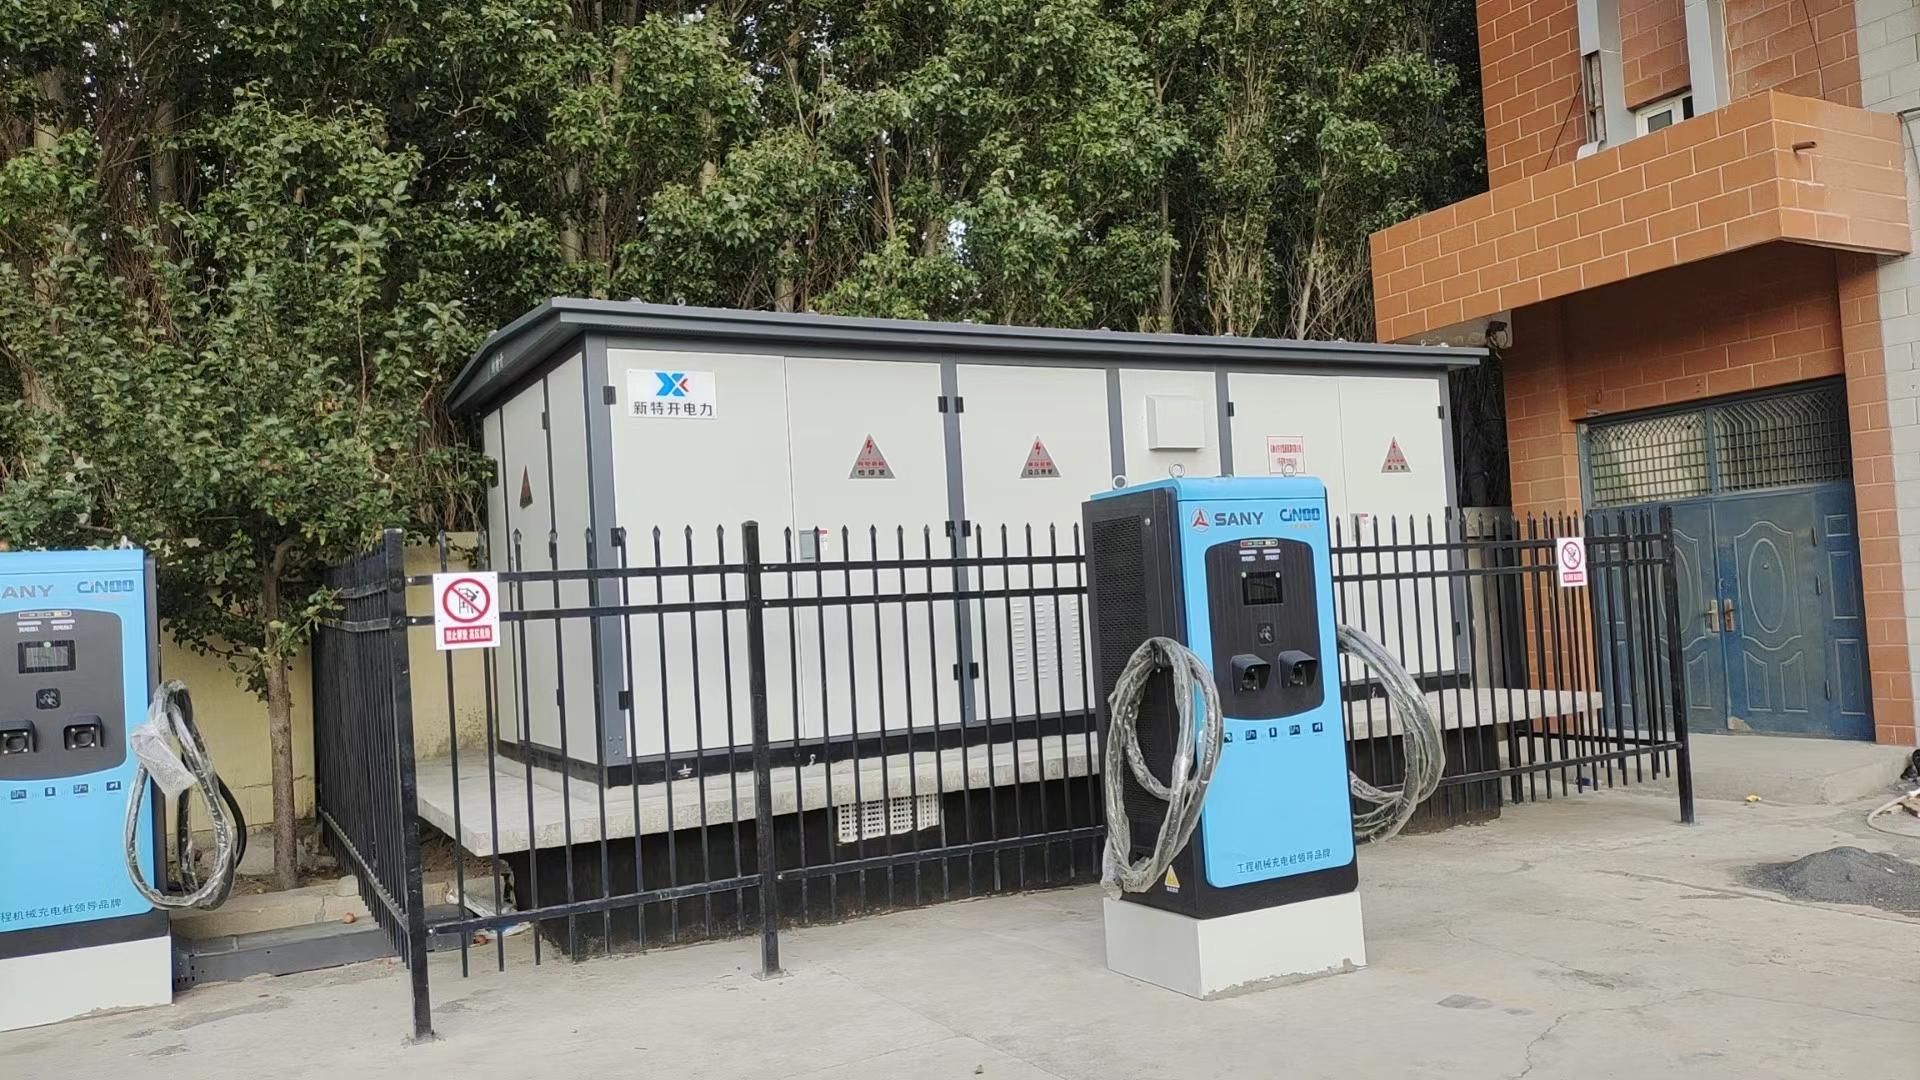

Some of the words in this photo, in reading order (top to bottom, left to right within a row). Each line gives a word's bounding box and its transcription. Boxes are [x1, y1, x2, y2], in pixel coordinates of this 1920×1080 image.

[633, 401, 713, 416] 新特开电力
[1214, 511, 1264, 527] SANY
[1236, 848, 1332, 874] 工程机械充电桩领导品牌
